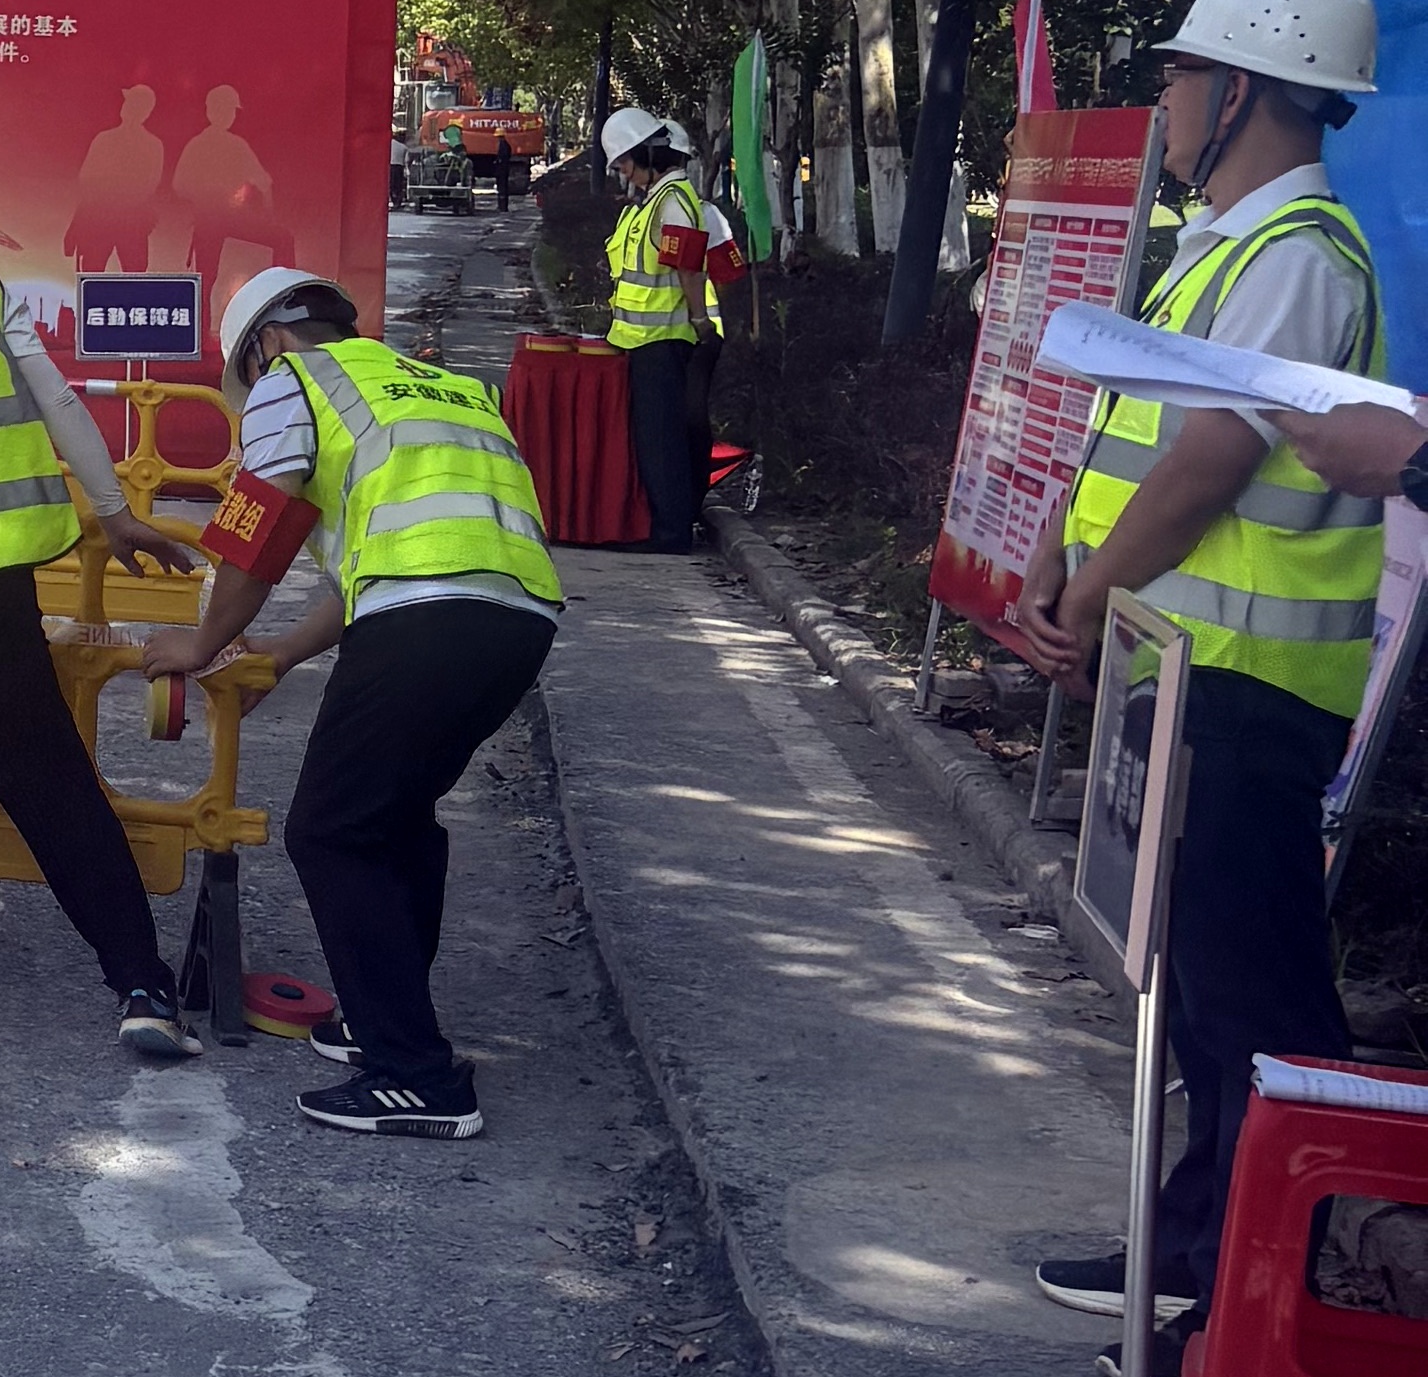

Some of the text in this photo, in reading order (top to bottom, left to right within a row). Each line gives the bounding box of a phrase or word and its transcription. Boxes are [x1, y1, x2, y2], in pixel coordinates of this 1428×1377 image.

[469, 118, 520, 129] HITACHI
[87, 307, 191, 326] 后勤保障组
